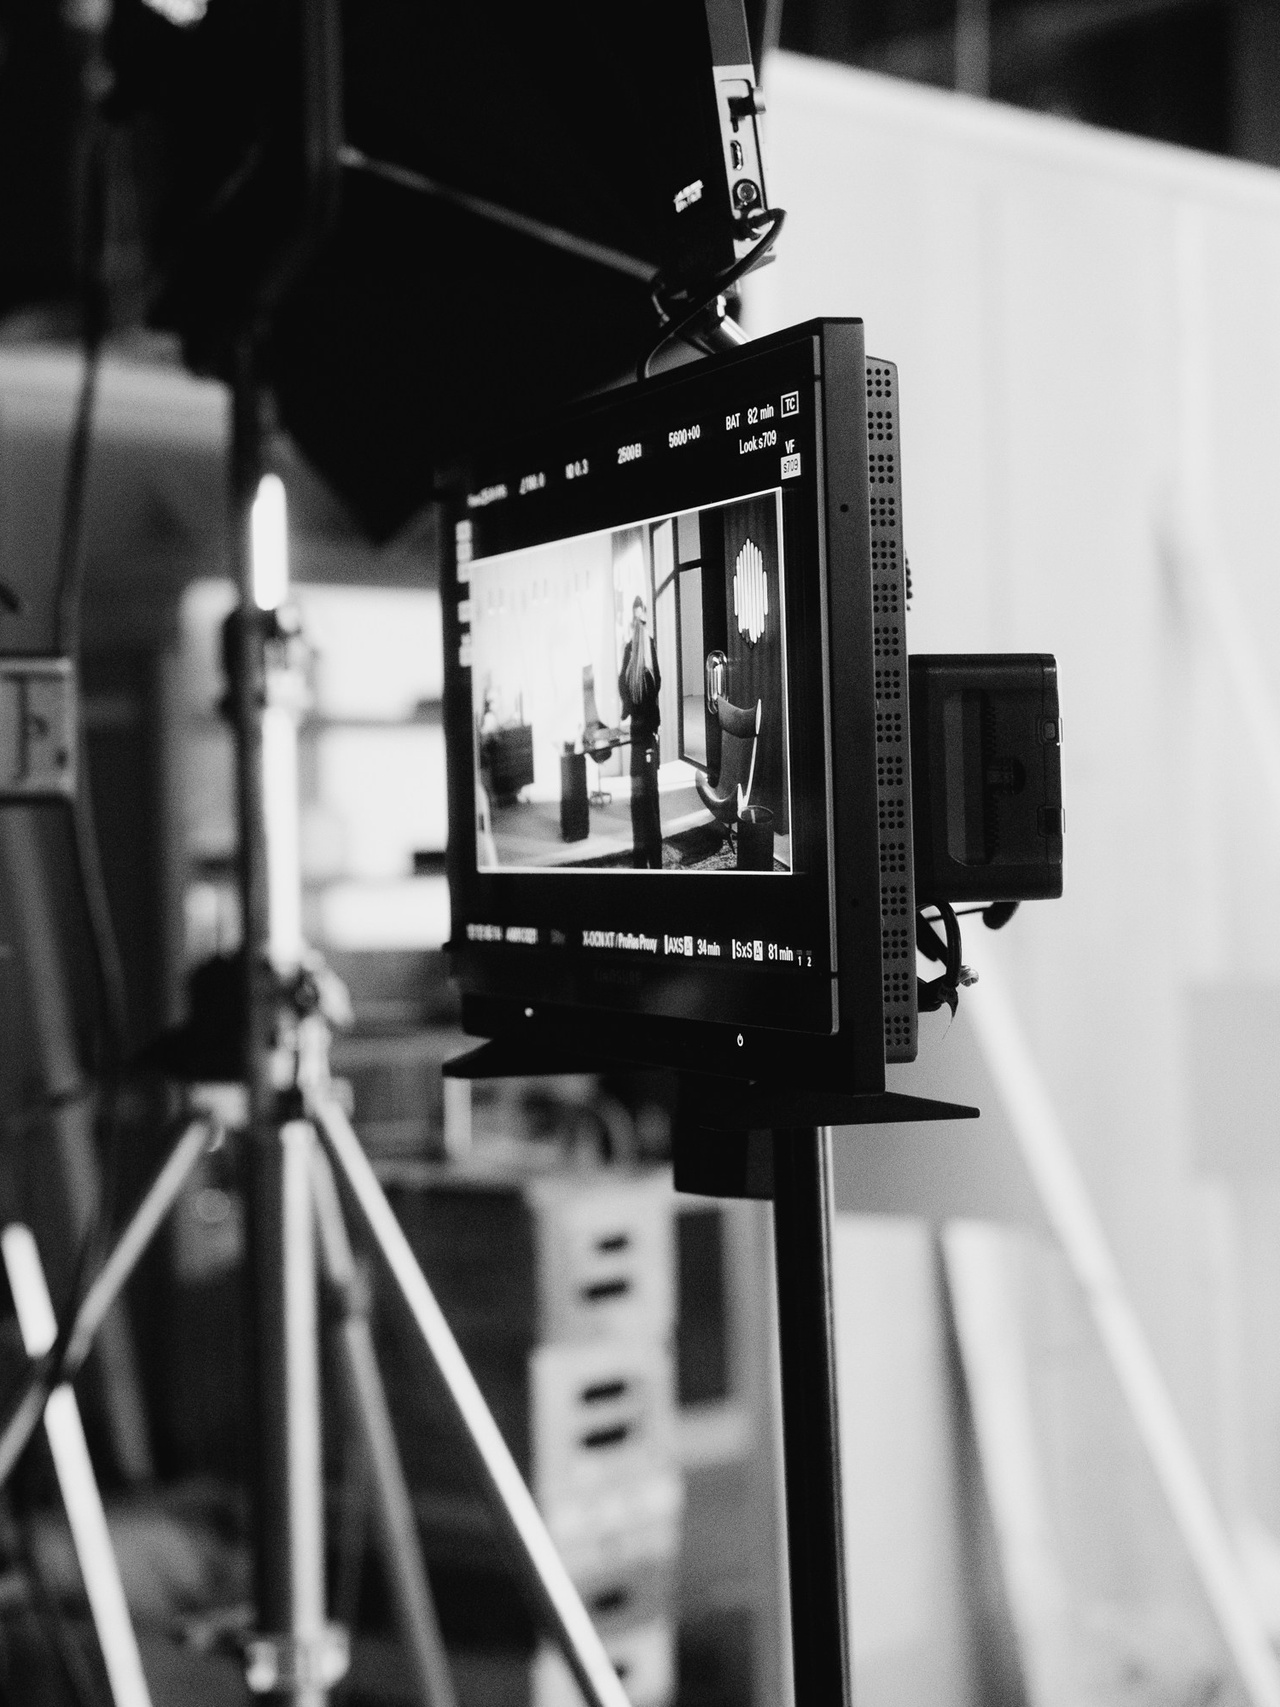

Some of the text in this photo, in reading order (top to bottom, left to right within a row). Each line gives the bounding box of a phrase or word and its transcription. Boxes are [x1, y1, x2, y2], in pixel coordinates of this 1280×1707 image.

[784, 397, 796, 412] TC
[725, 403, 775, 431] BAT 82 min
[669, 424, 701, 449] 5600+00
[739, 429, 777, 455] Look s709
[784, 438, 796, 455] VF
[783, 458, 799, 474] s709
[668, 936, 684, 954] AXS
[697, 938, 707, 956] 34
[707, 941, 721, 957] min
[736, 941, 753, 959] SxS
[768, 943, 778, 960] 81
[779, 946, 794, 962] min
[797, 955, 812, 967] 1 2
